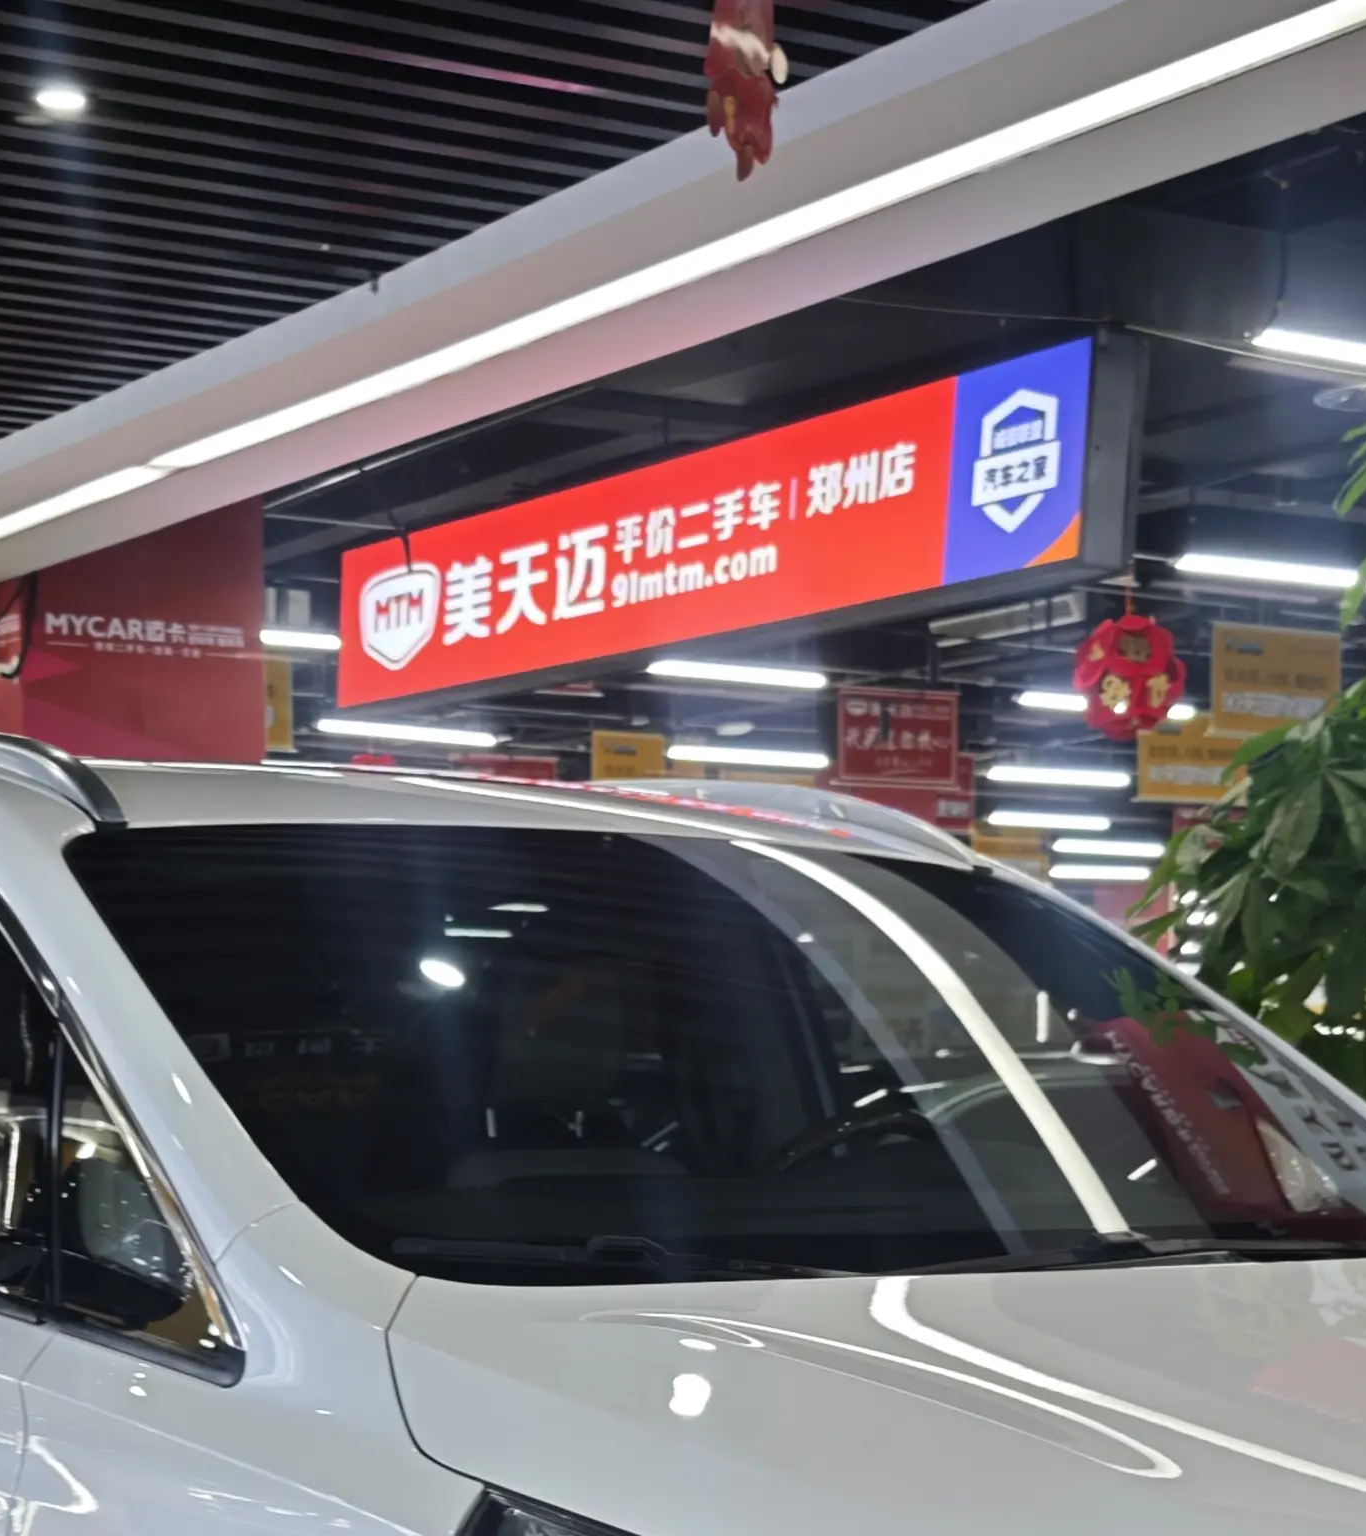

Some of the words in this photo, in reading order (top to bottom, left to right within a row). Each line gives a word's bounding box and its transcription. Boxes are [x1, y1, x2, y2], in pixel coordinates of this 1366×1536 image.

[805, 442, 918, 520] 郑州店
[613, 480, 782, 564] 平价二手车
[441, 523, 610, 647] 美天迈
[610, 542, 779, 610] 91mtm.com
